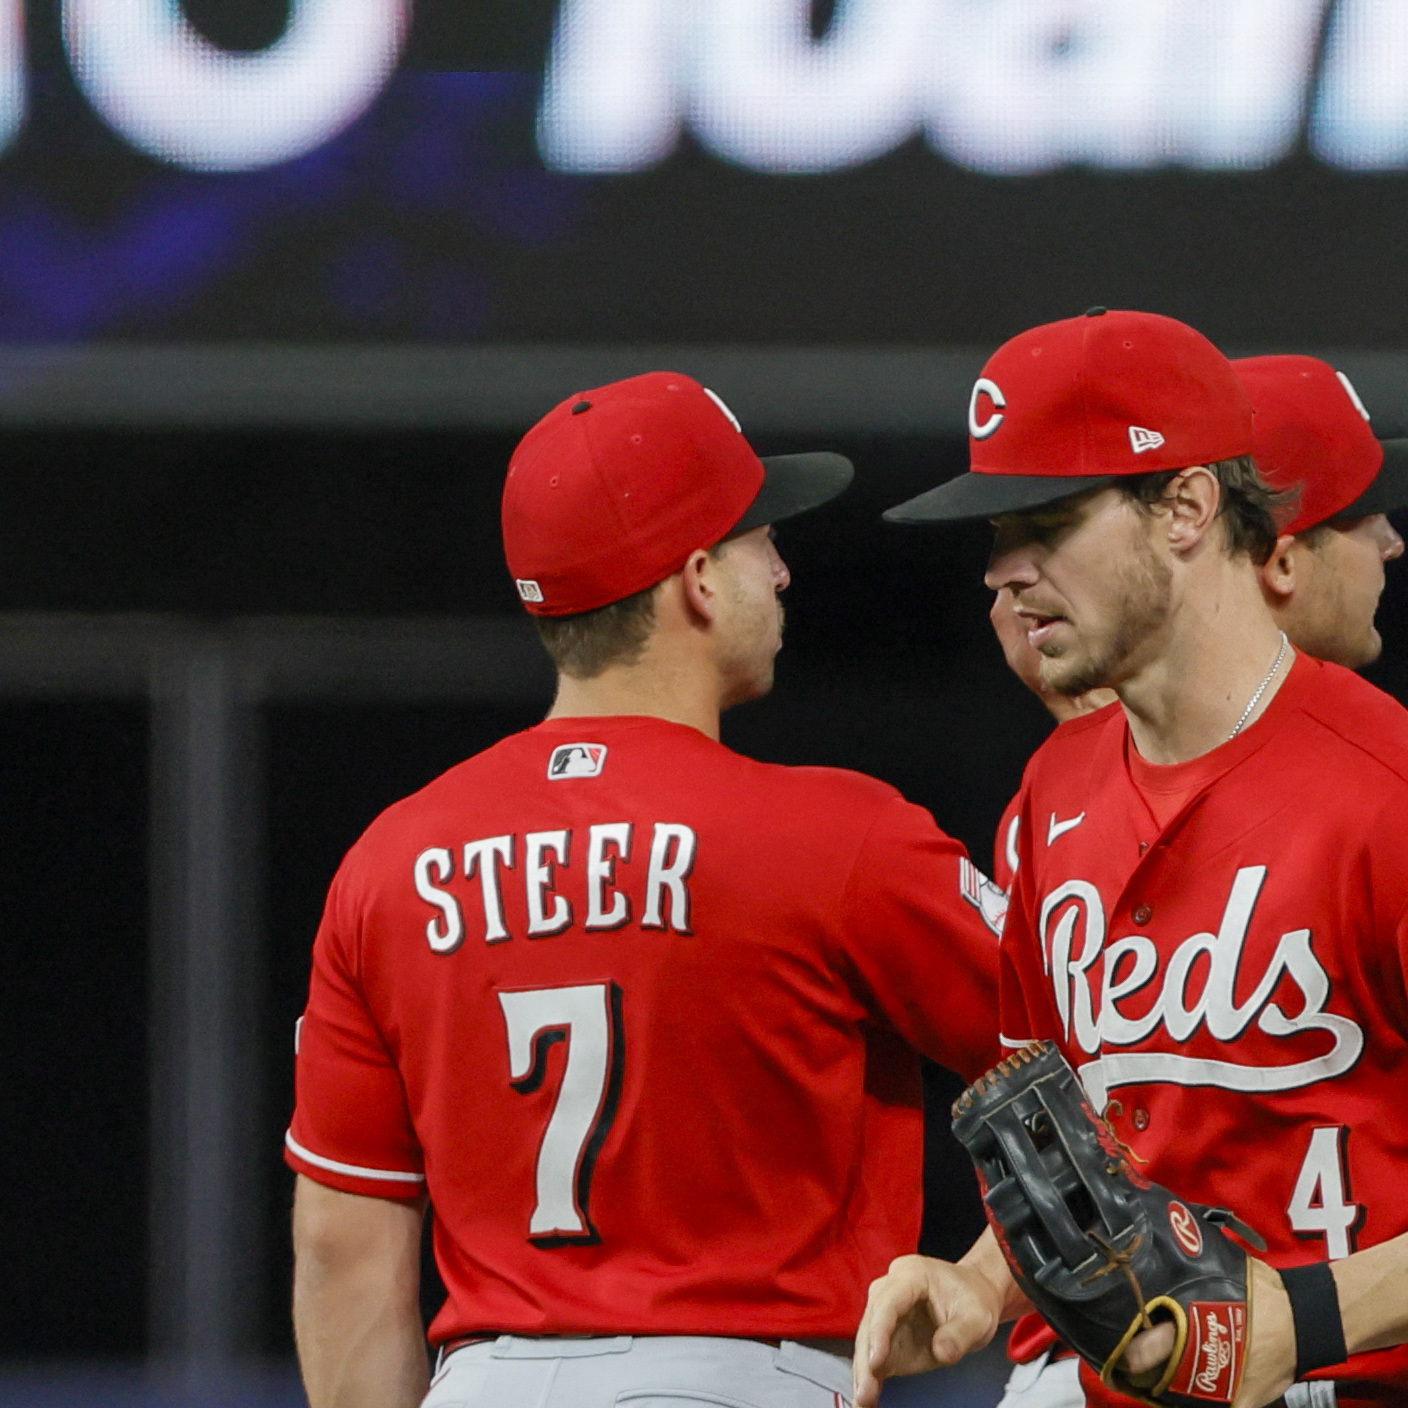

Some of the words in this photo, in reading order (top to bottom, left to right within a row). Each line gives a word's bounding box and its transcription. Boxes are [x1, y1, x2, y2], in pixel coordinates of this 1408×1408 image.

[968, 377, 1006, 440] C
[414, 822, 698, 955] STEER
[1039, 866, 1364, 1096] Reds
[495, 978, 624, 1247] 7
[1286, 1124, 1367, 1260] 4
[1196, 1311, 1230, 1393] Rawlings
